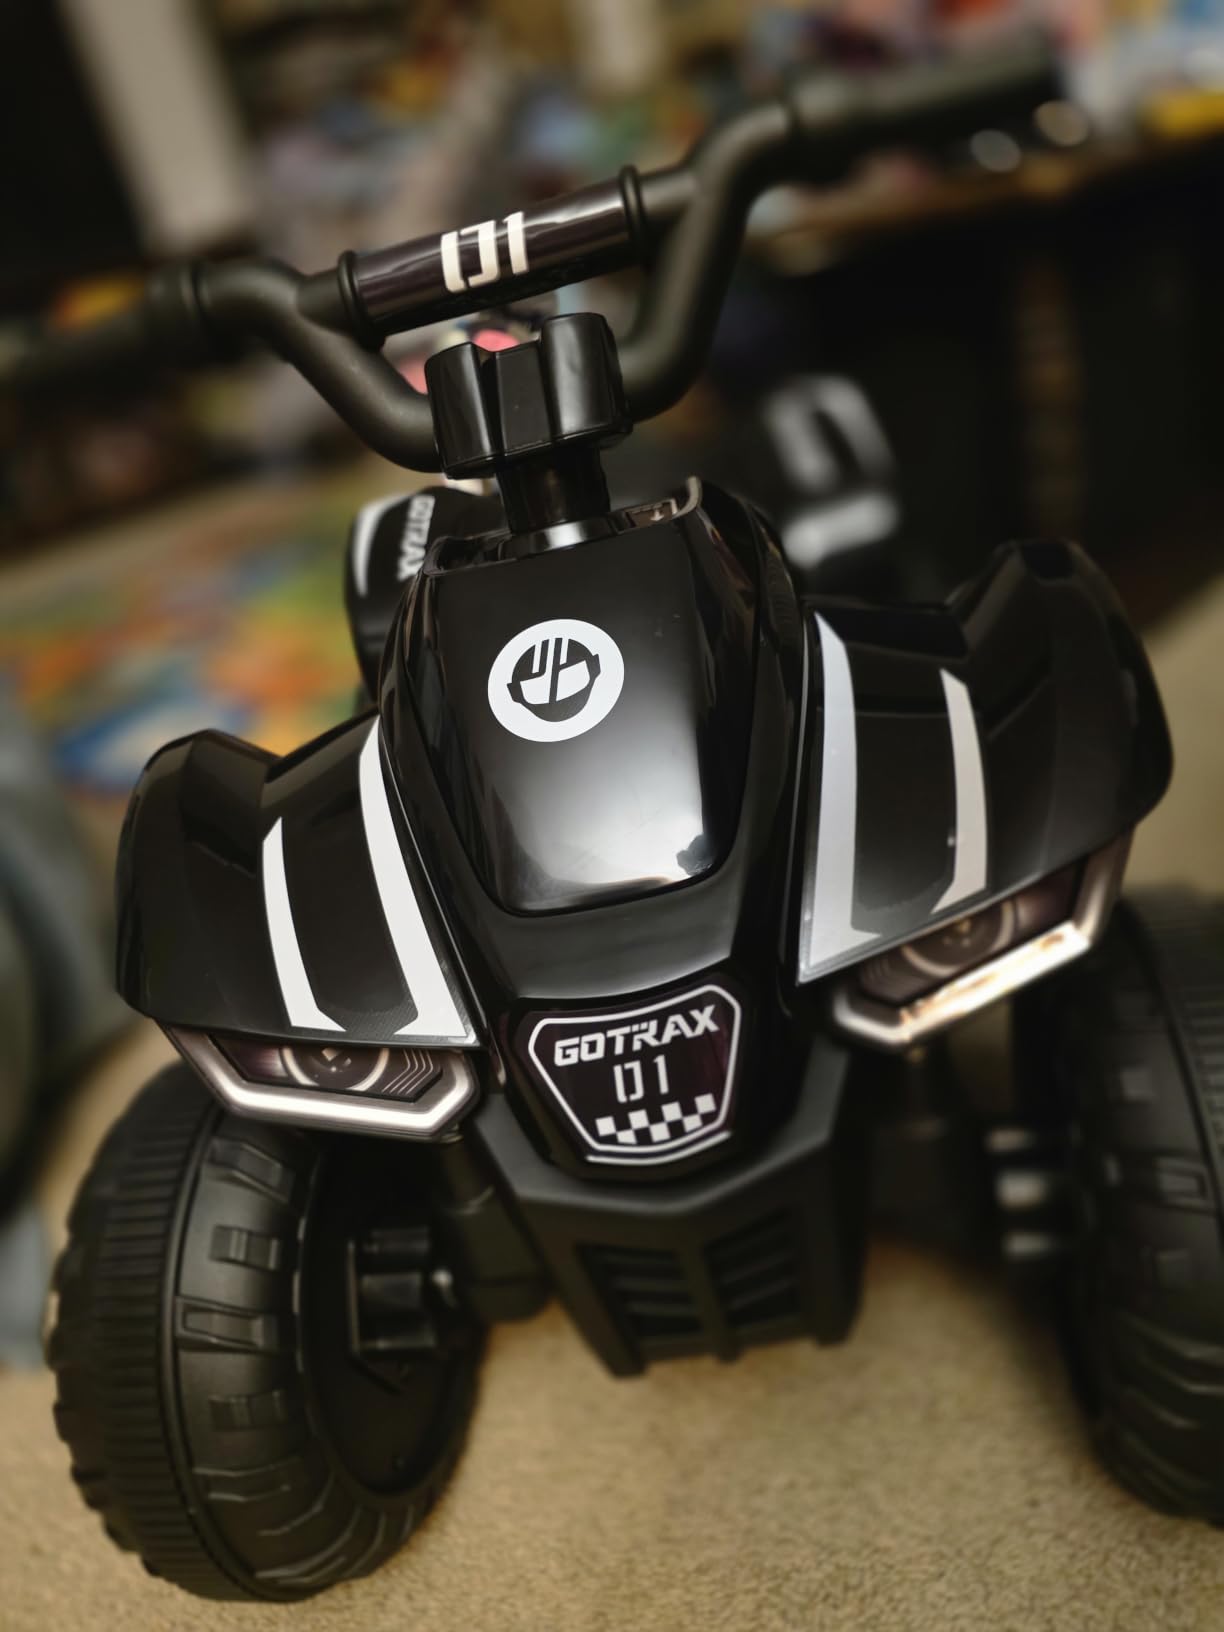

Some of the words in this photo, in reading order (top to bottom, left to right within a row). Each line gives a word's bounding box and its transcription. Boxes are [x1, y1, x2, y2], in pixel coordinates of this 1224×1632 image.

[440, 211, 529, 293] 01
[554, 1005, 719, 1066] GOTRAX
[613, 1054, 669, 1103] 01
